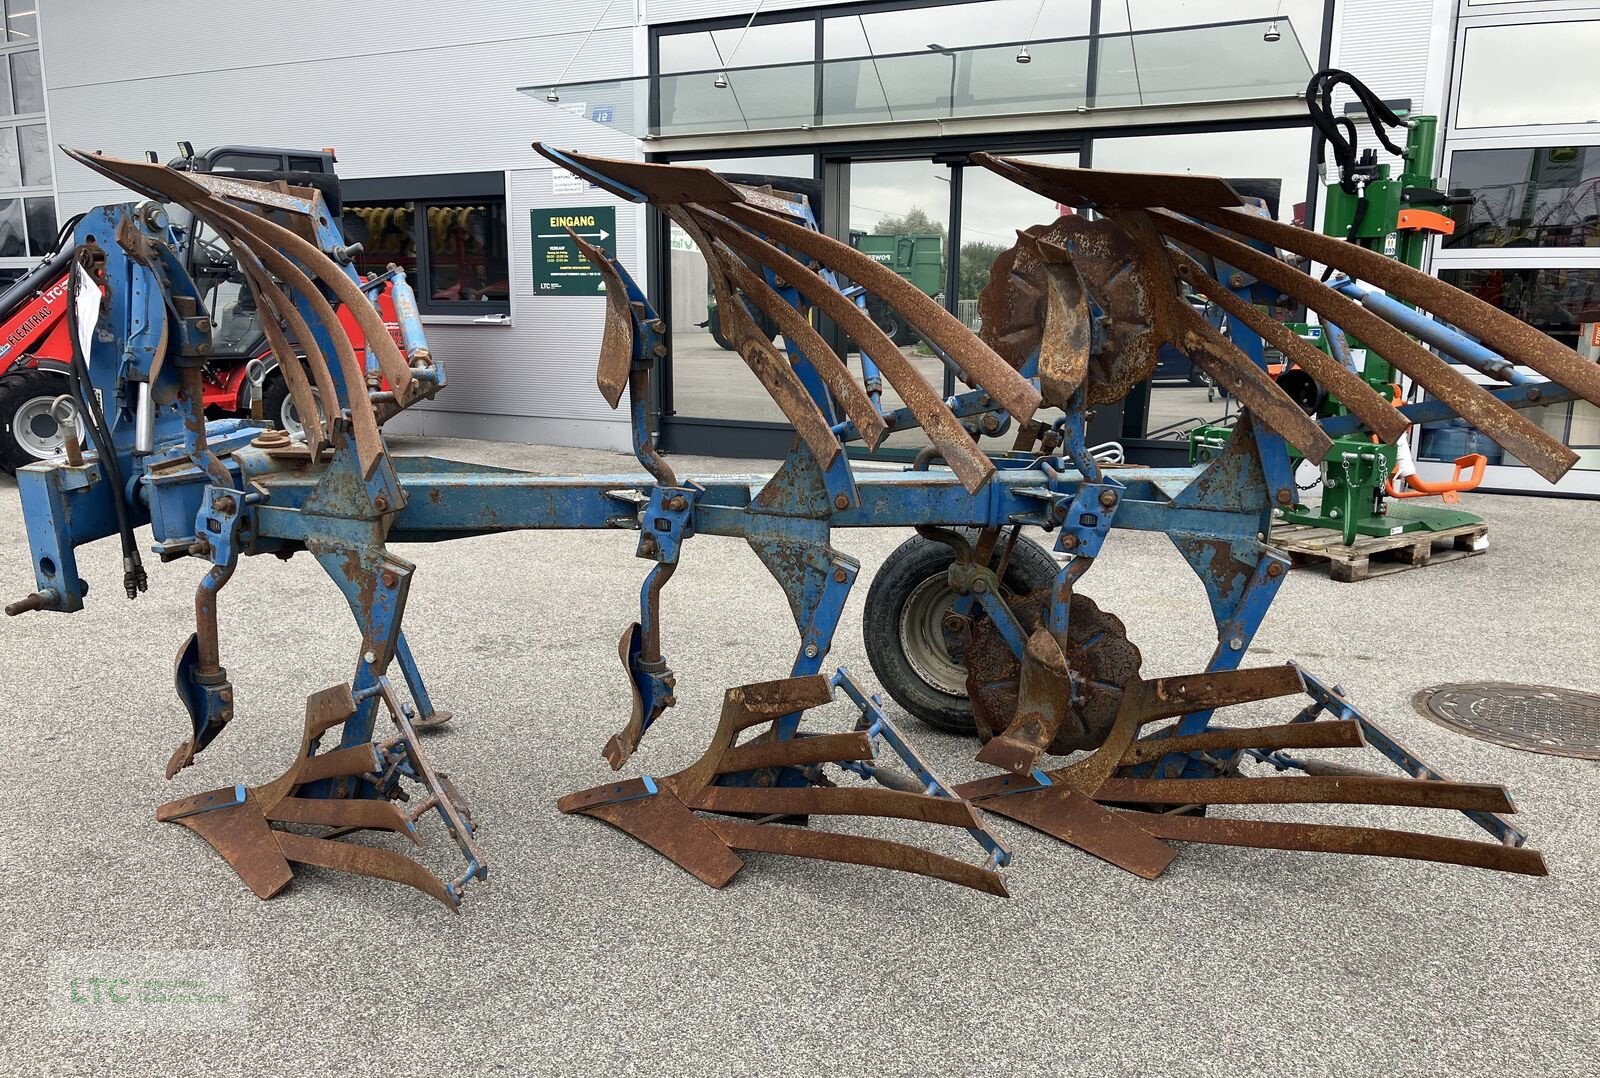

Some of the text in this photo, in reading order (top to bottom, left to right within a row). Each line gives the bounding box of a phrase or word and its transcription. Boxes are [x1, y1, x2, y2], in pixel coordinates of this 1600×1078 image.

[550, 216, 595, 227] EINGANG
[540, 282, 551, 290] LTC
[43, 286, 63, 304] LTC
[8, 306, 53, 345] FLEXITRAC
